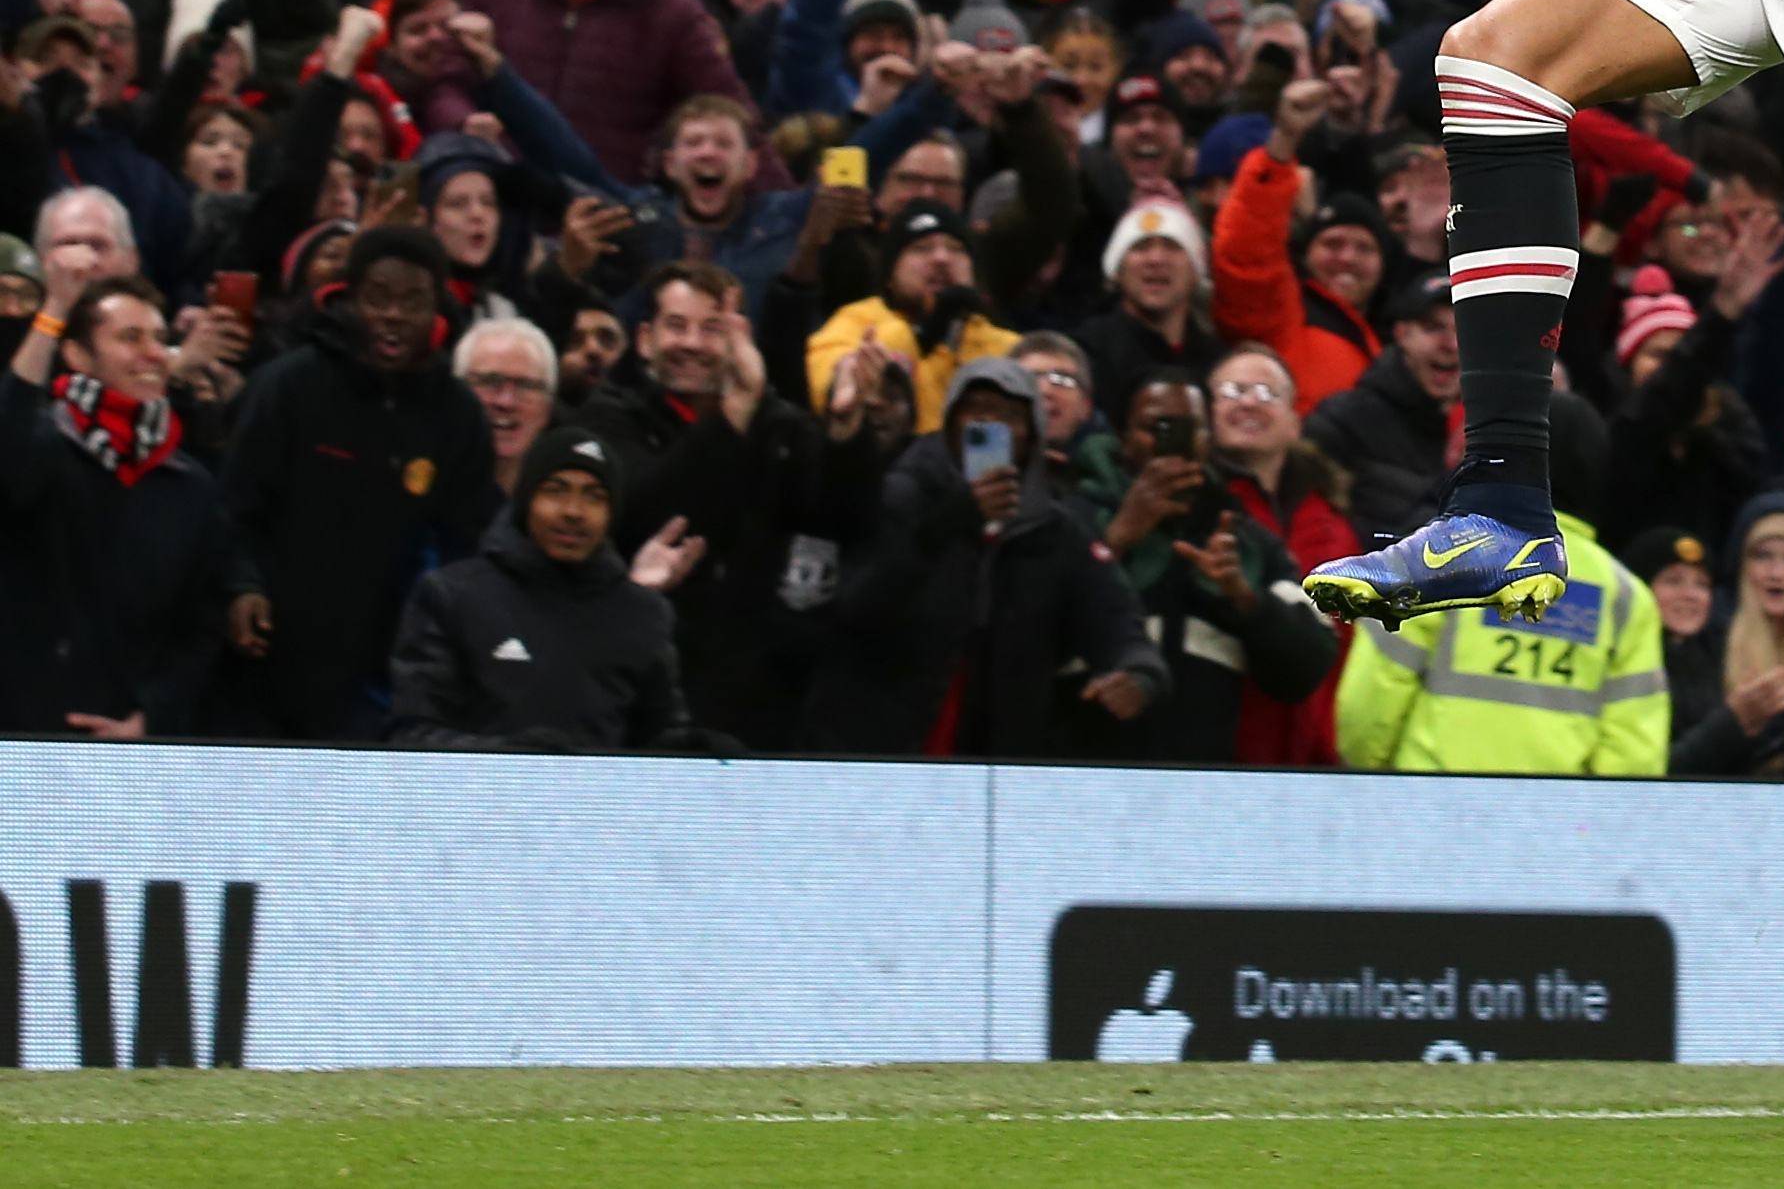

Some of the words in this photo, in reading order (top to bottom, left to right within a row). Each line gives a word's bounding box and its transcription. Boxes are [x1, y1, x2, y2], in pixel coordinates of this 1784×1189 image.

[1493, 632, 1577, 685] 214
[1234, 966, 1458, 1021] Download
[1469, 978, 1524, 1021] on
[1538, 968, 1611, 1022] the
